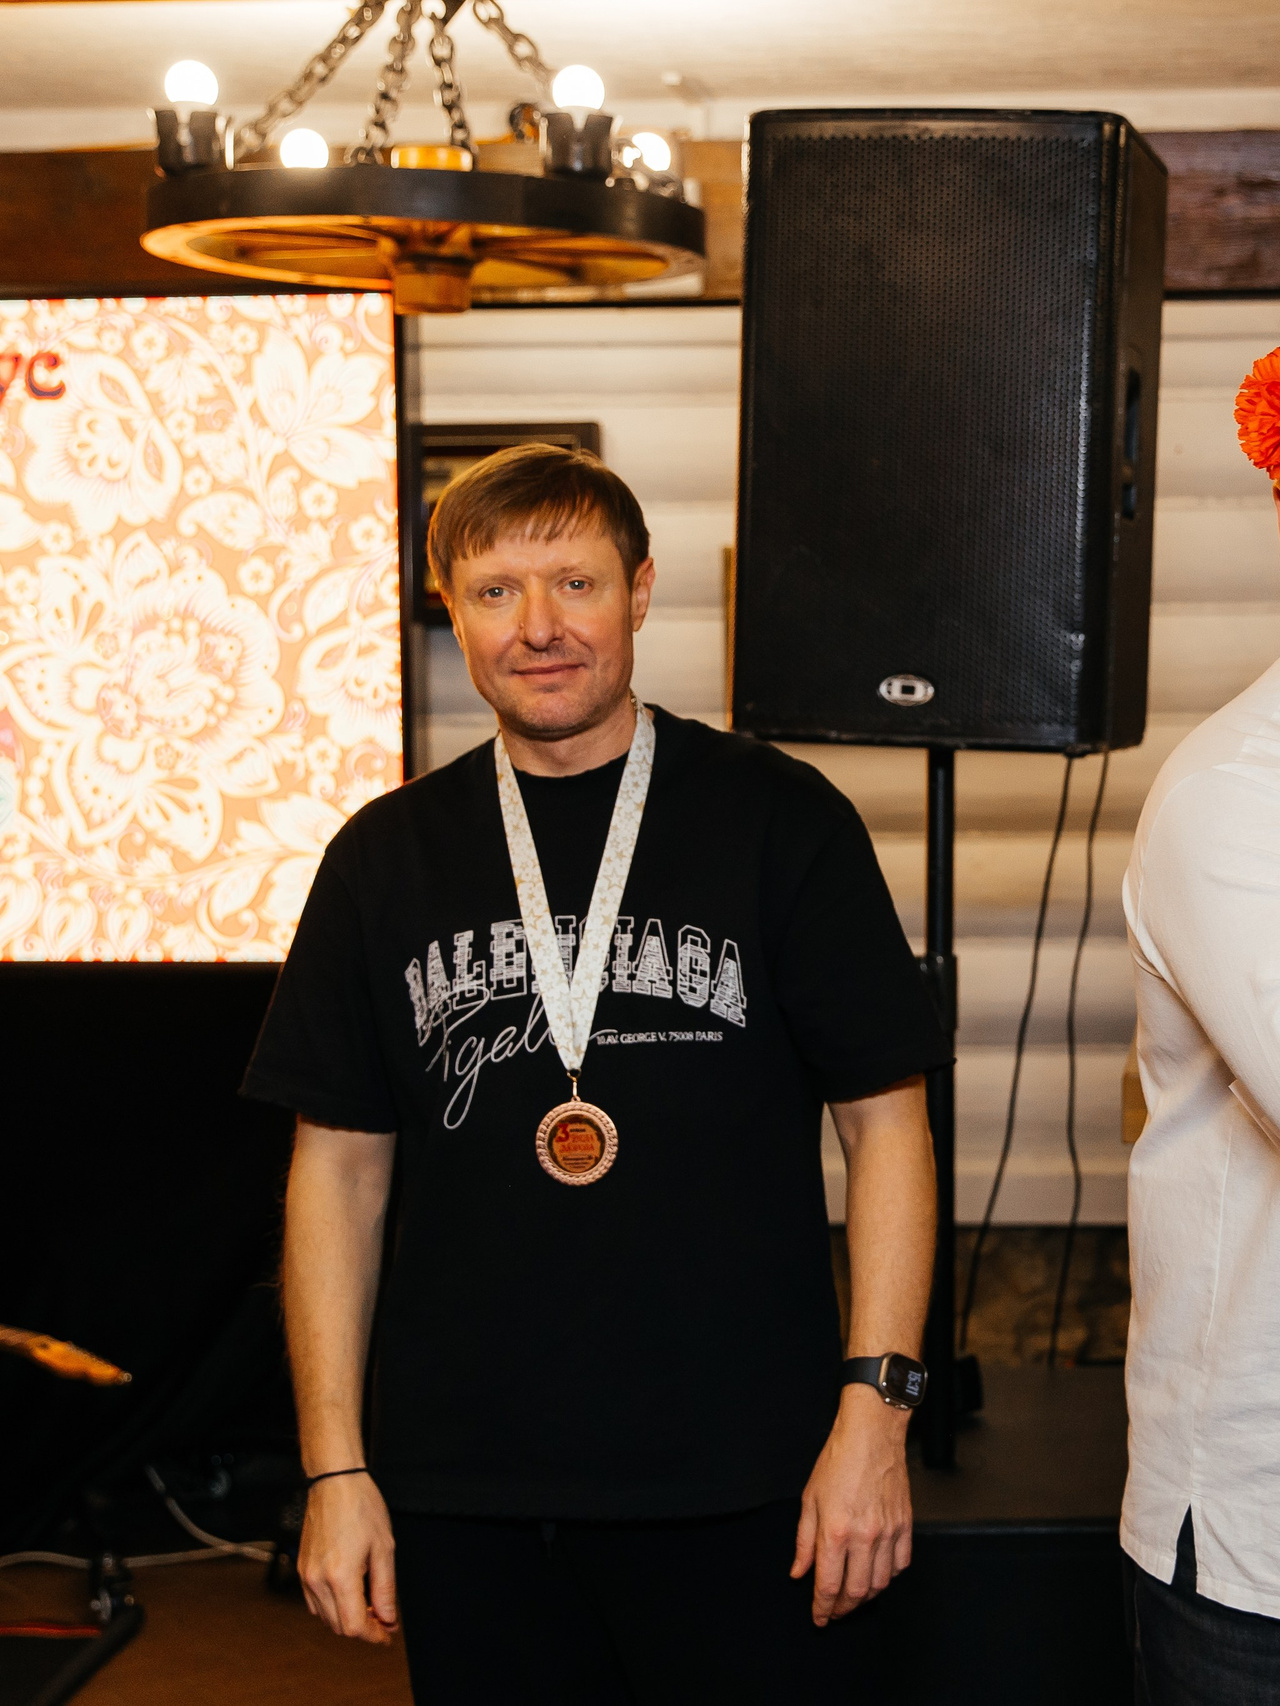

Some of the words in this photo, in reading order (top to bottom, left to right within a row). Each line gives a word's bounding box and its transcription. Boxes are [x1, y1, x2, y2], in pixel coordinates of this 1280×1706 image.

[620, 1032, 657, 1044] GEORGE
[695, 1031, 723, 1041] PARIS
[555, 1123, 569, 1142] 3
